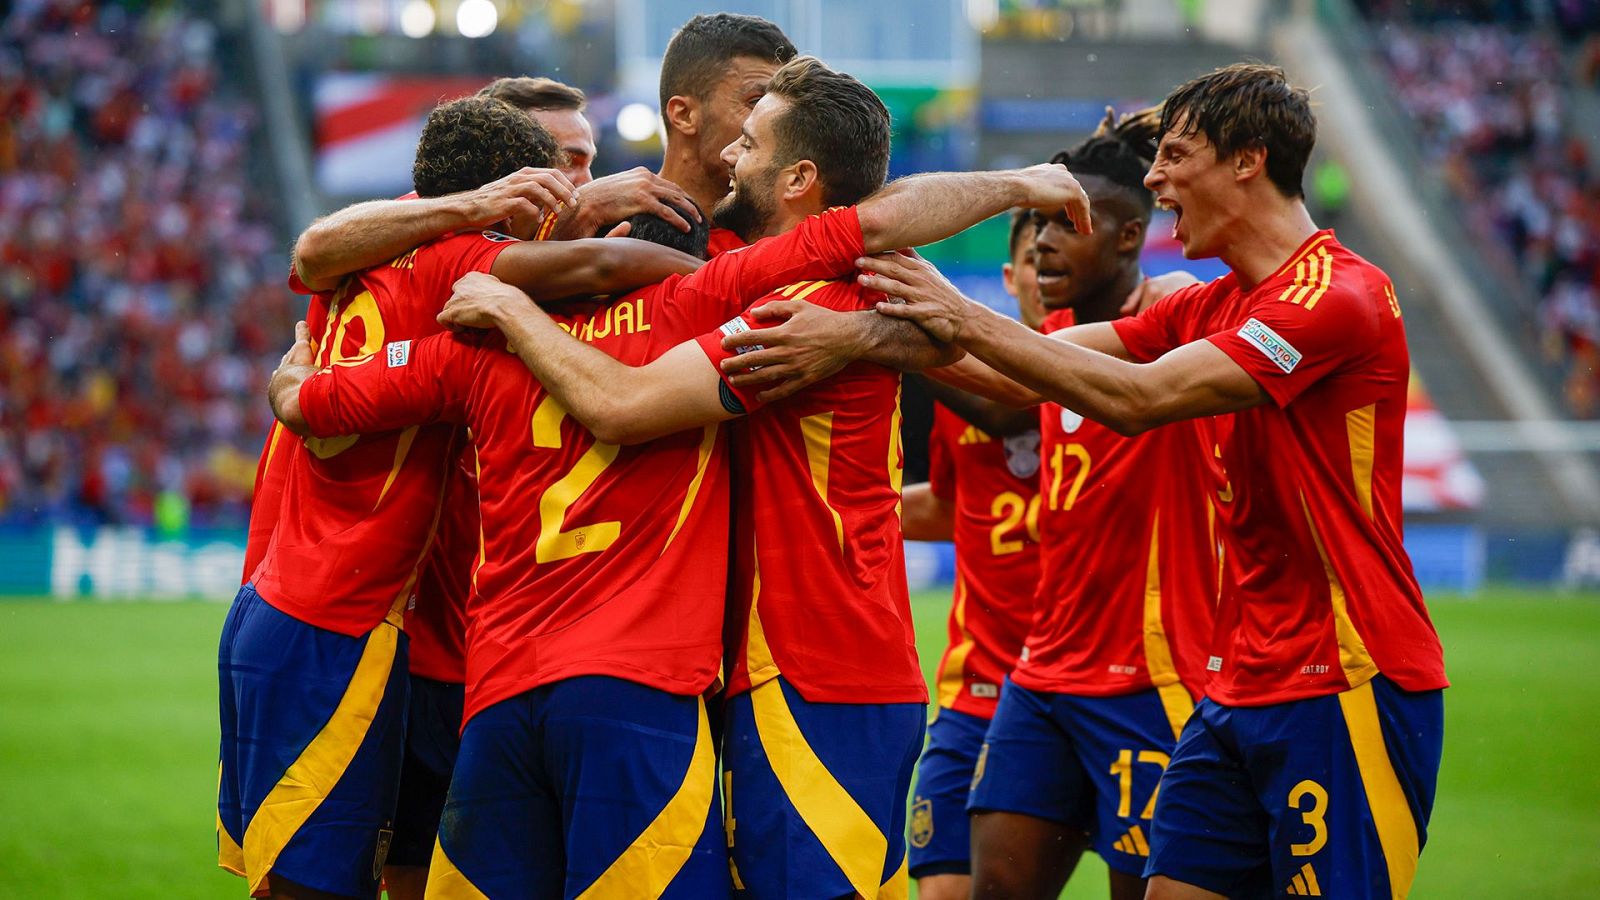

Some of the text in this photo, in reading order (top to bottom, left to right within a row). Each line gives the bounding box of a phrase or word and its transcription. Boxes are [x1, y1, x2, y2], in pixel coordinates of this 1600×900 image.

[395, 342, 404, 365] TION
[1244, 323, 1297, 367] FOUNDATION
[532, 394, 621, 564] 2
[1050, 443, 1092, 511] 17
[1110, 749, 1171, 819] 17
[1288, 779, 1329, 856] 3
